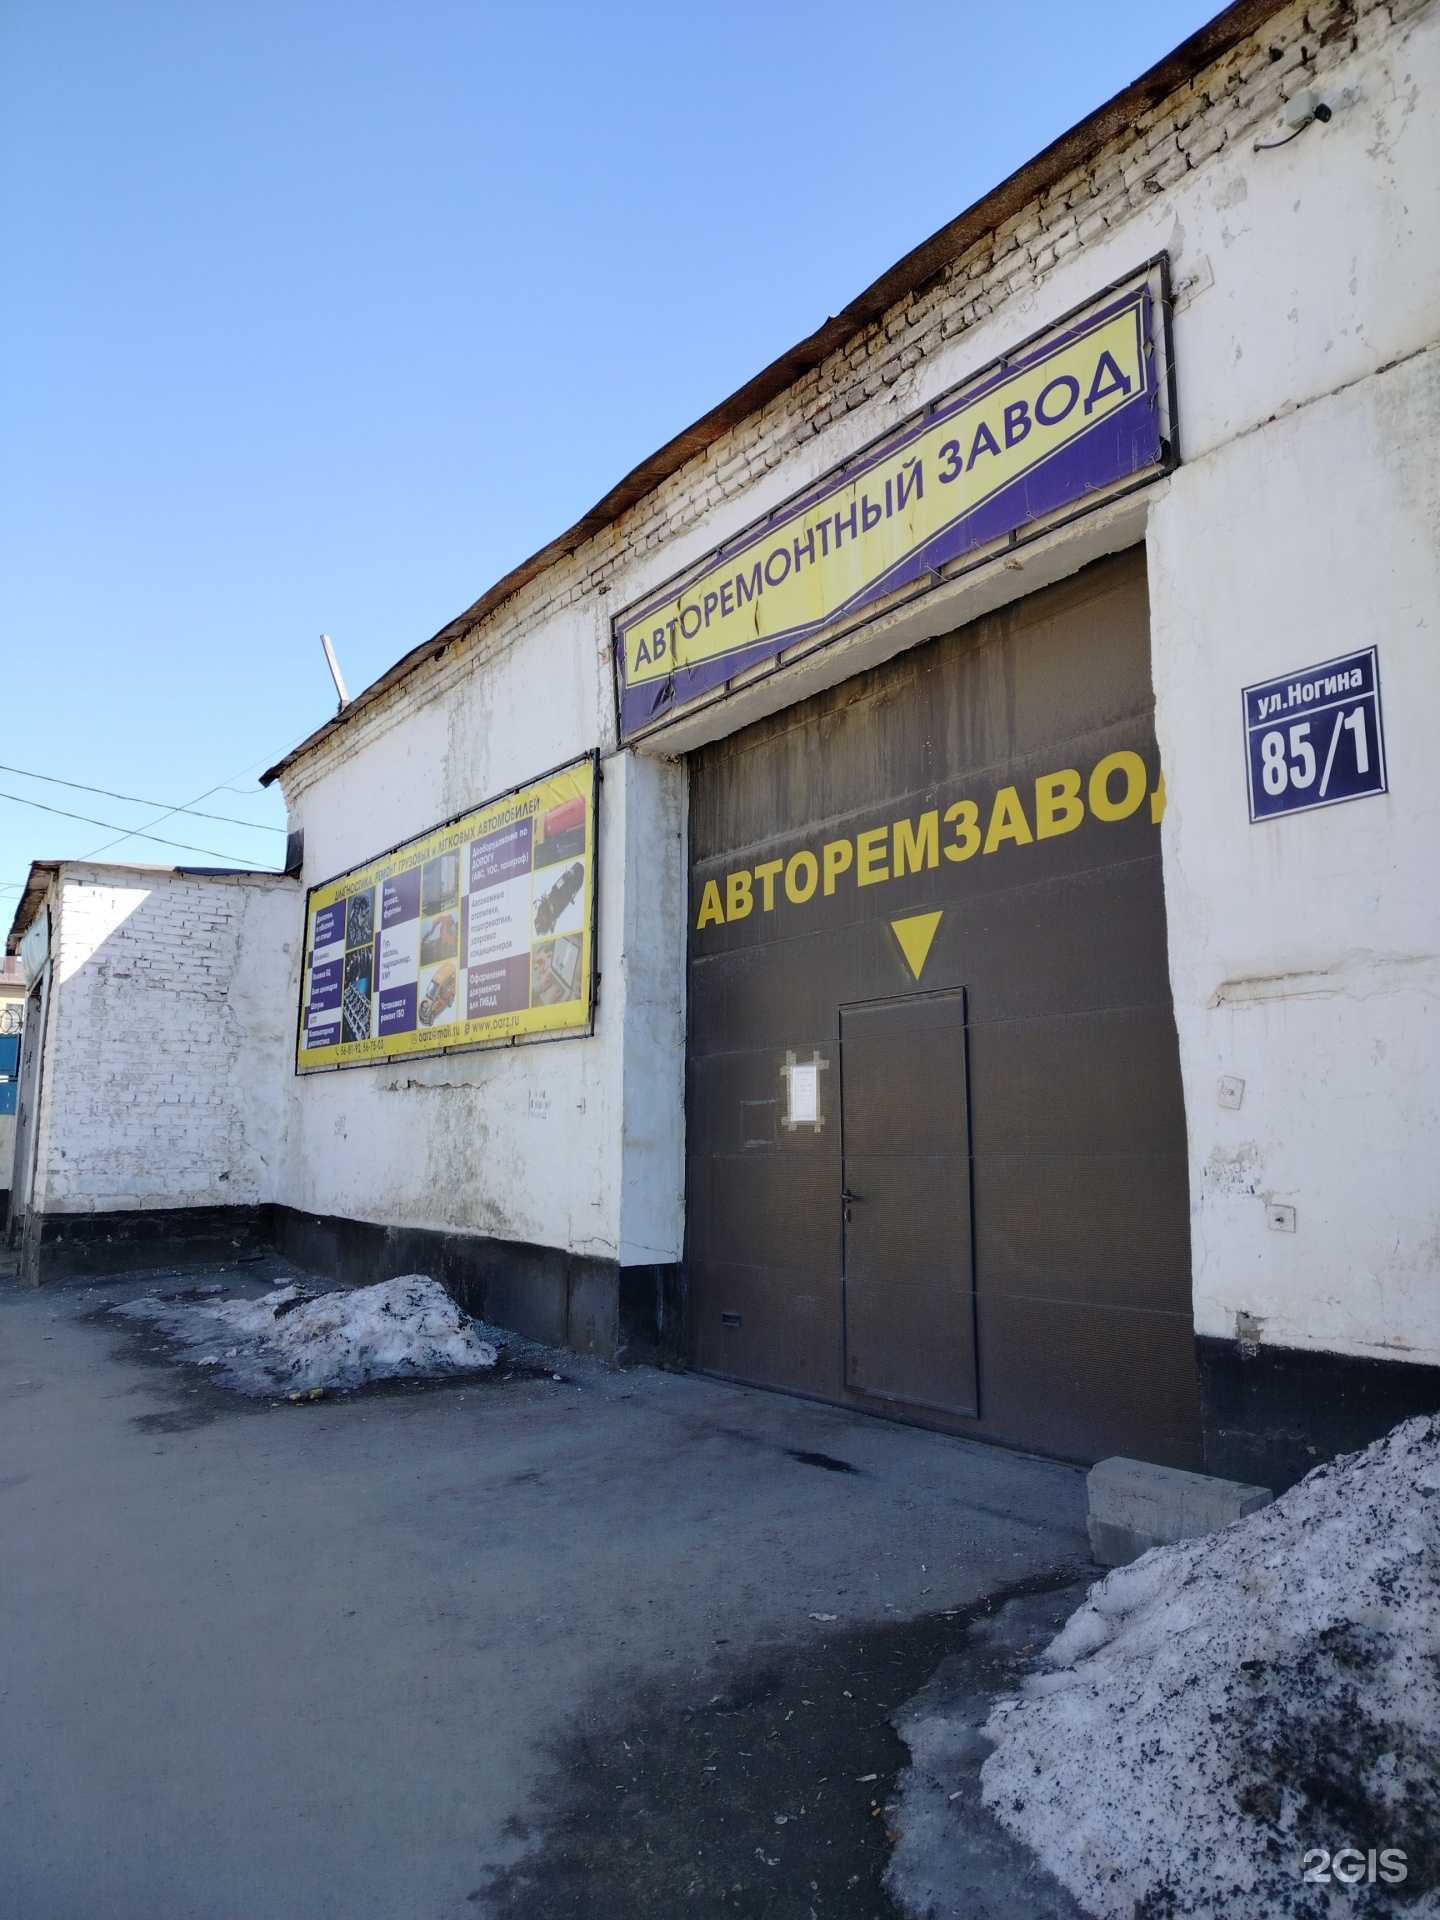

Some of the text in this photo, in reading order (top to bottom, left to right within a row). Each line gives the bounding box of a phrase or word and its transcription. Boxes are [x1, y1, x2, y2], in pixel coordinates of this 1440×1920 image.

[634, 350, 1131, 672] АВТОРЕМОНТНЫЙ ЗАВОД
[1257, 667, 1363, 720] ул.Ногина
[1261, 706, 1369, 797] 85/1
[478, 797, 540, 833] АВТОМОБИЛЕЙ
[471, 1016, 520, 1033] www.oarz.ru
